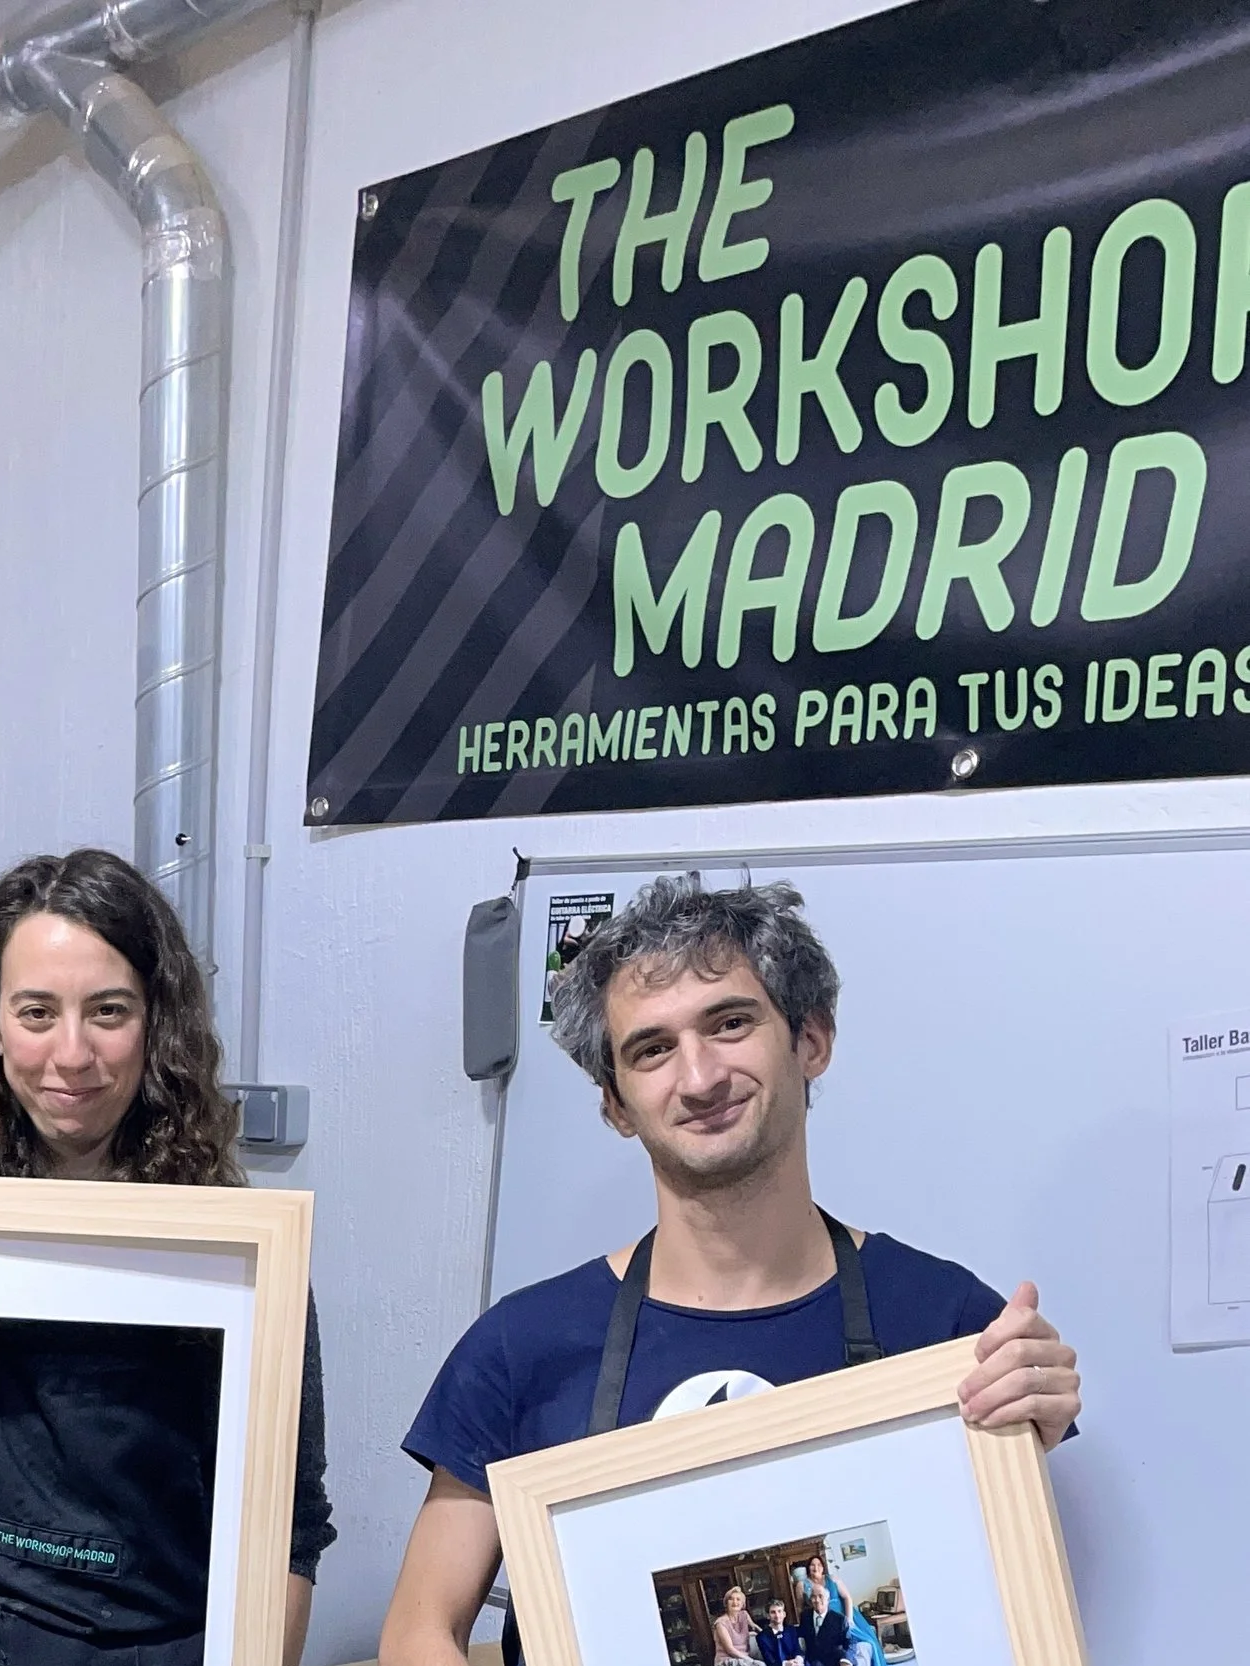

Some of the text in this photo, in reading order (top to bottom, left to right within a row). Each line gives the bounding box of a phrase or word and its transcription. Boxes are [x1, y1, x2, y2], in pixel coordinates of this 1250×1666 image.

[551, 103, 795, 322] THE
[613, 430, 1208, 679] MADRID
[456, 692, 776, 775] HERRAMIENTAS
[793, 677, 938, 747] PARA
[957, 663, 1064, 732] TUS
[1182, 1034, 1224, 1053] Taller
[15, 1535, 74, 1559] WORKSHOP
[74, 1548, 115, 1564] MADRID
